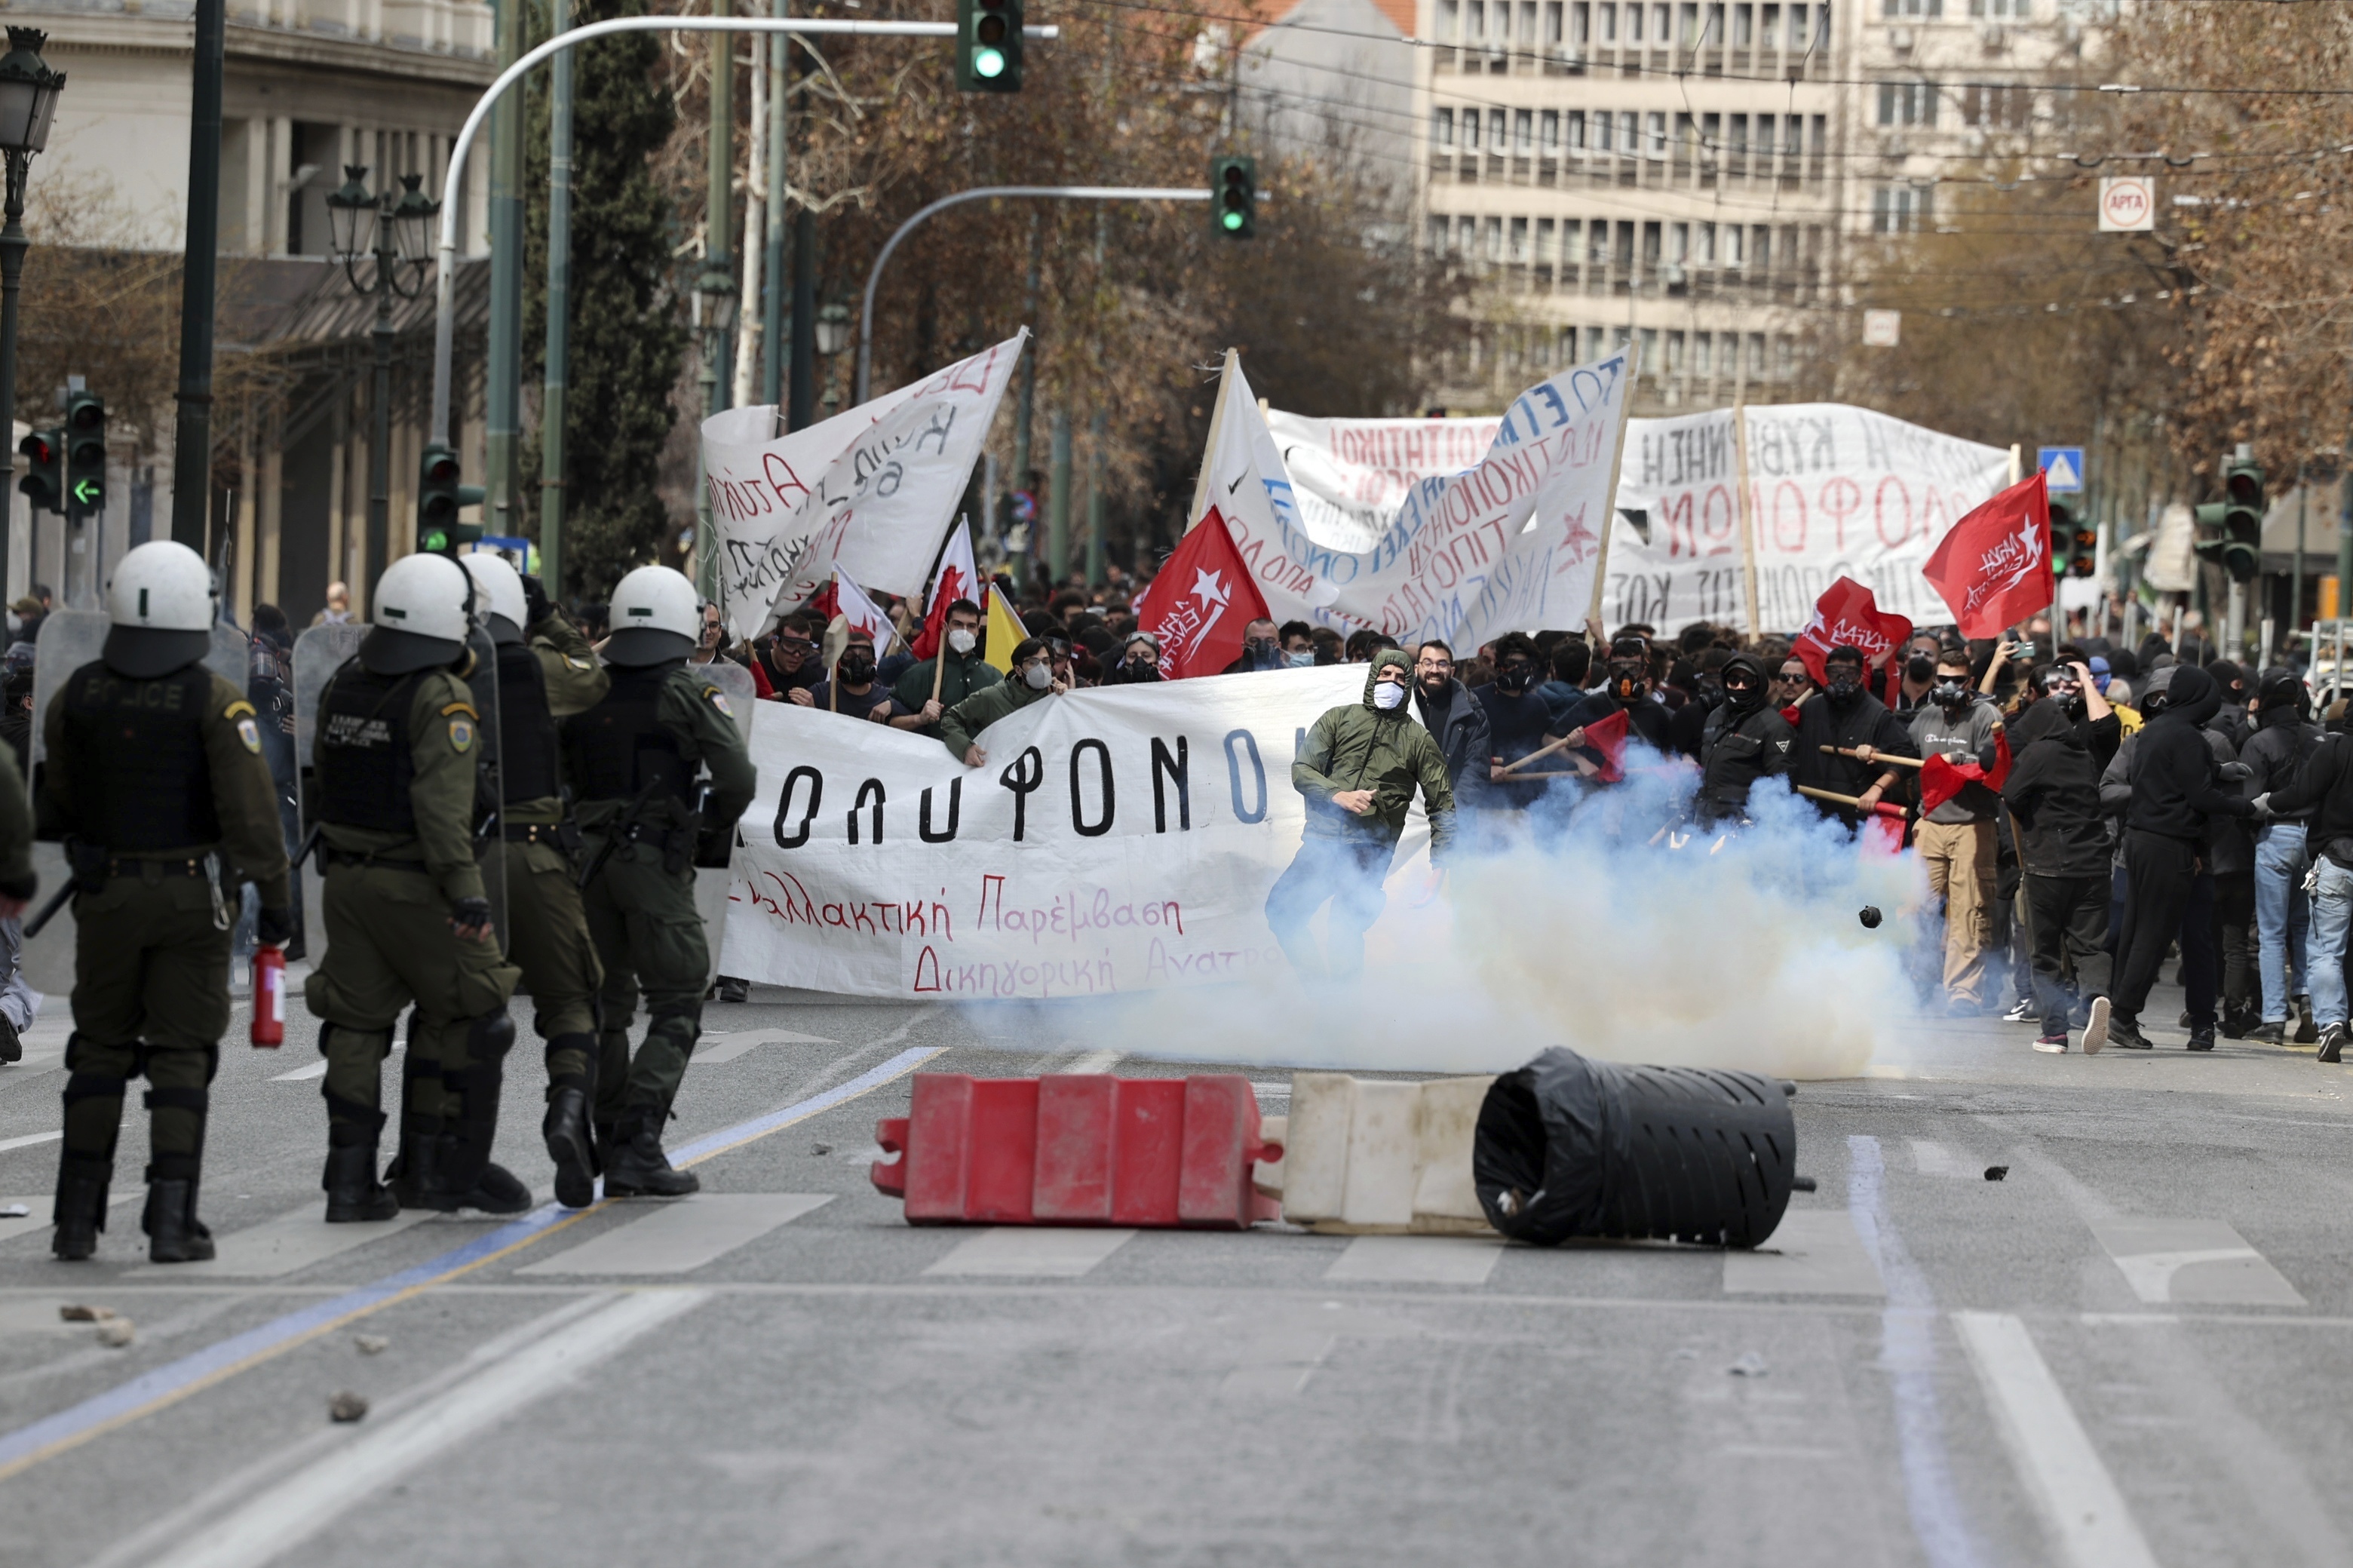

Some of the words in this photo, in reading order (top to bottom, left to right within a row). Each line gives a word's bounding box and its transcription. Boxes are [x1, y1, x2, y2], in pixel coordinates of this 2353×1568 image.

[2109, 194, 2143, 210] ΑΡΓΑ
[729, 871, 953, 942] ναλλακτική
[977, 873, 1183, 944] Παρέμβαση
[913, 944, 1118, 999] Δικηγορική
[1145, 936, 1284, 983] Ανατρο
